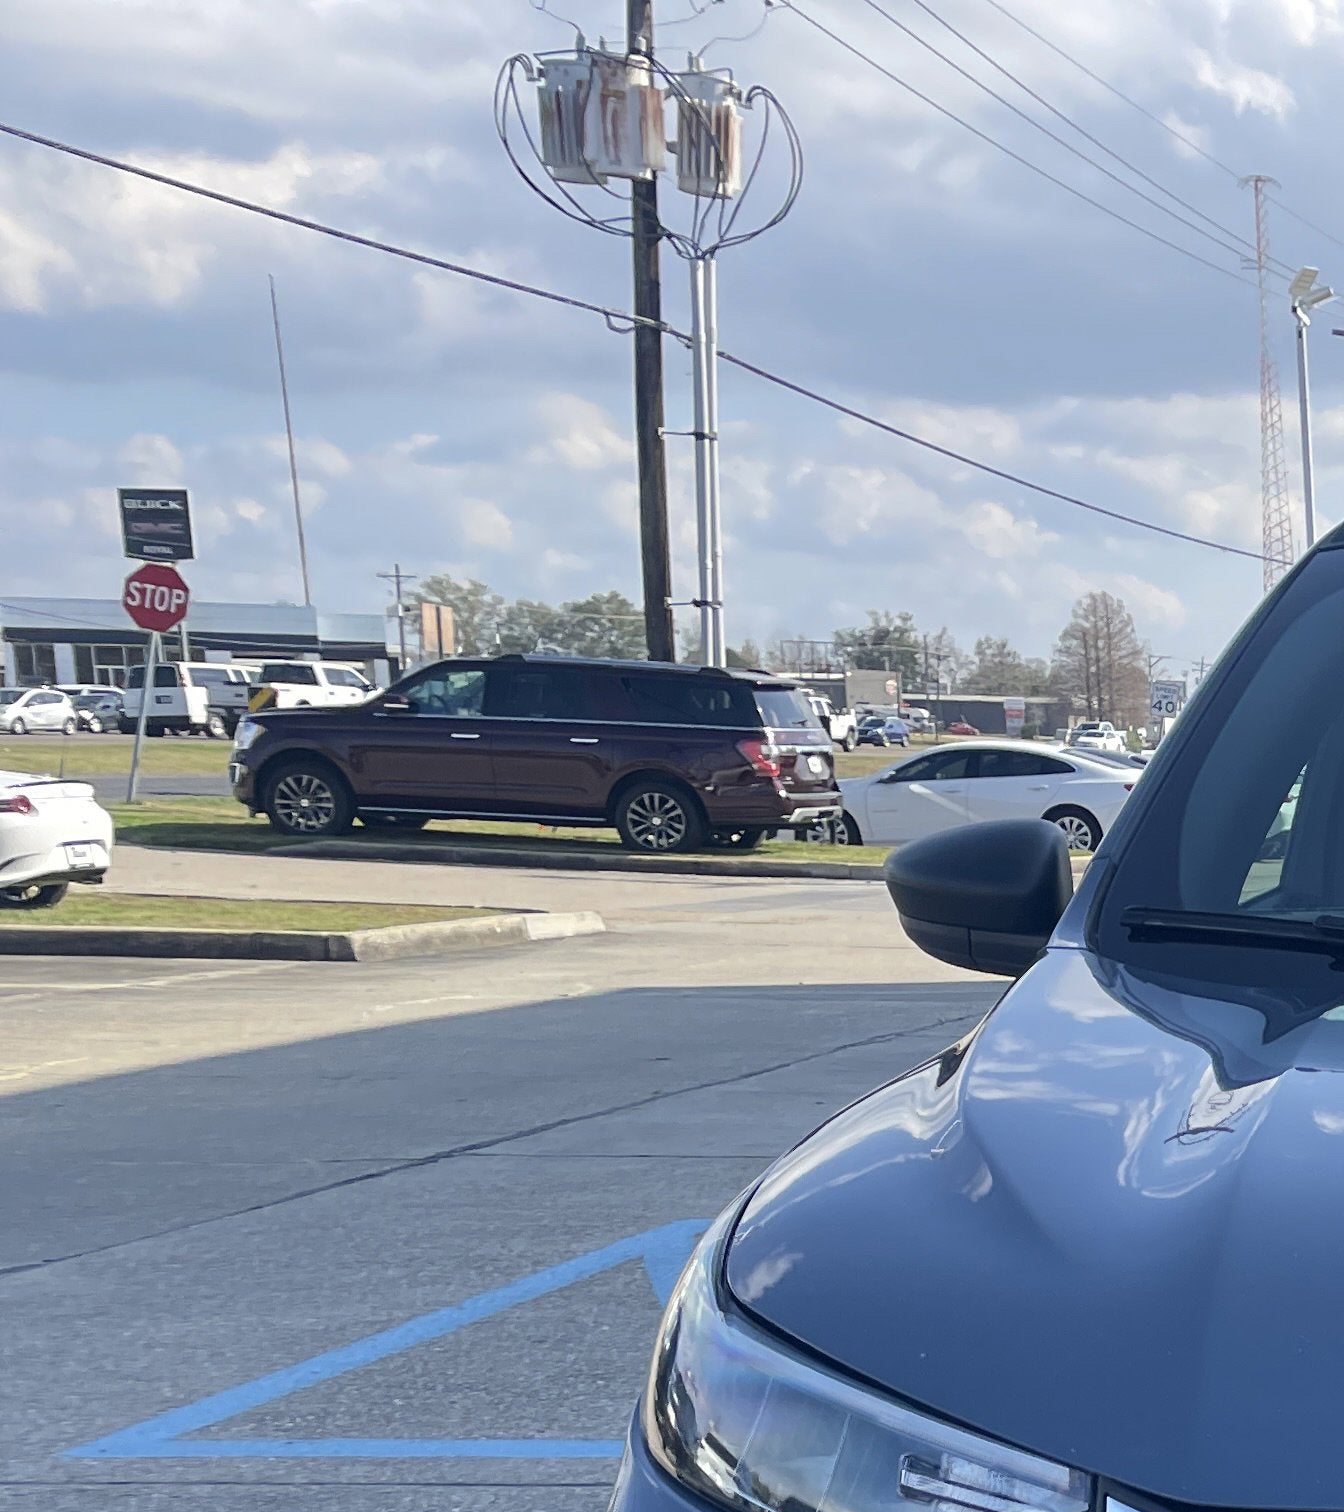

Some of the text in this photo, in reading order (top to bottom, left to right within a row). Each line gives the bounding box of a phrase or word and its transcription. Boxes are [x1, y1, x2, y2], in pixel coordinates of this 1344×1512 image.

[122, 498, 185, 511] BUICK
[126, 580, 187, 614] STOP
[1152, 700, 1175, 714] 40
